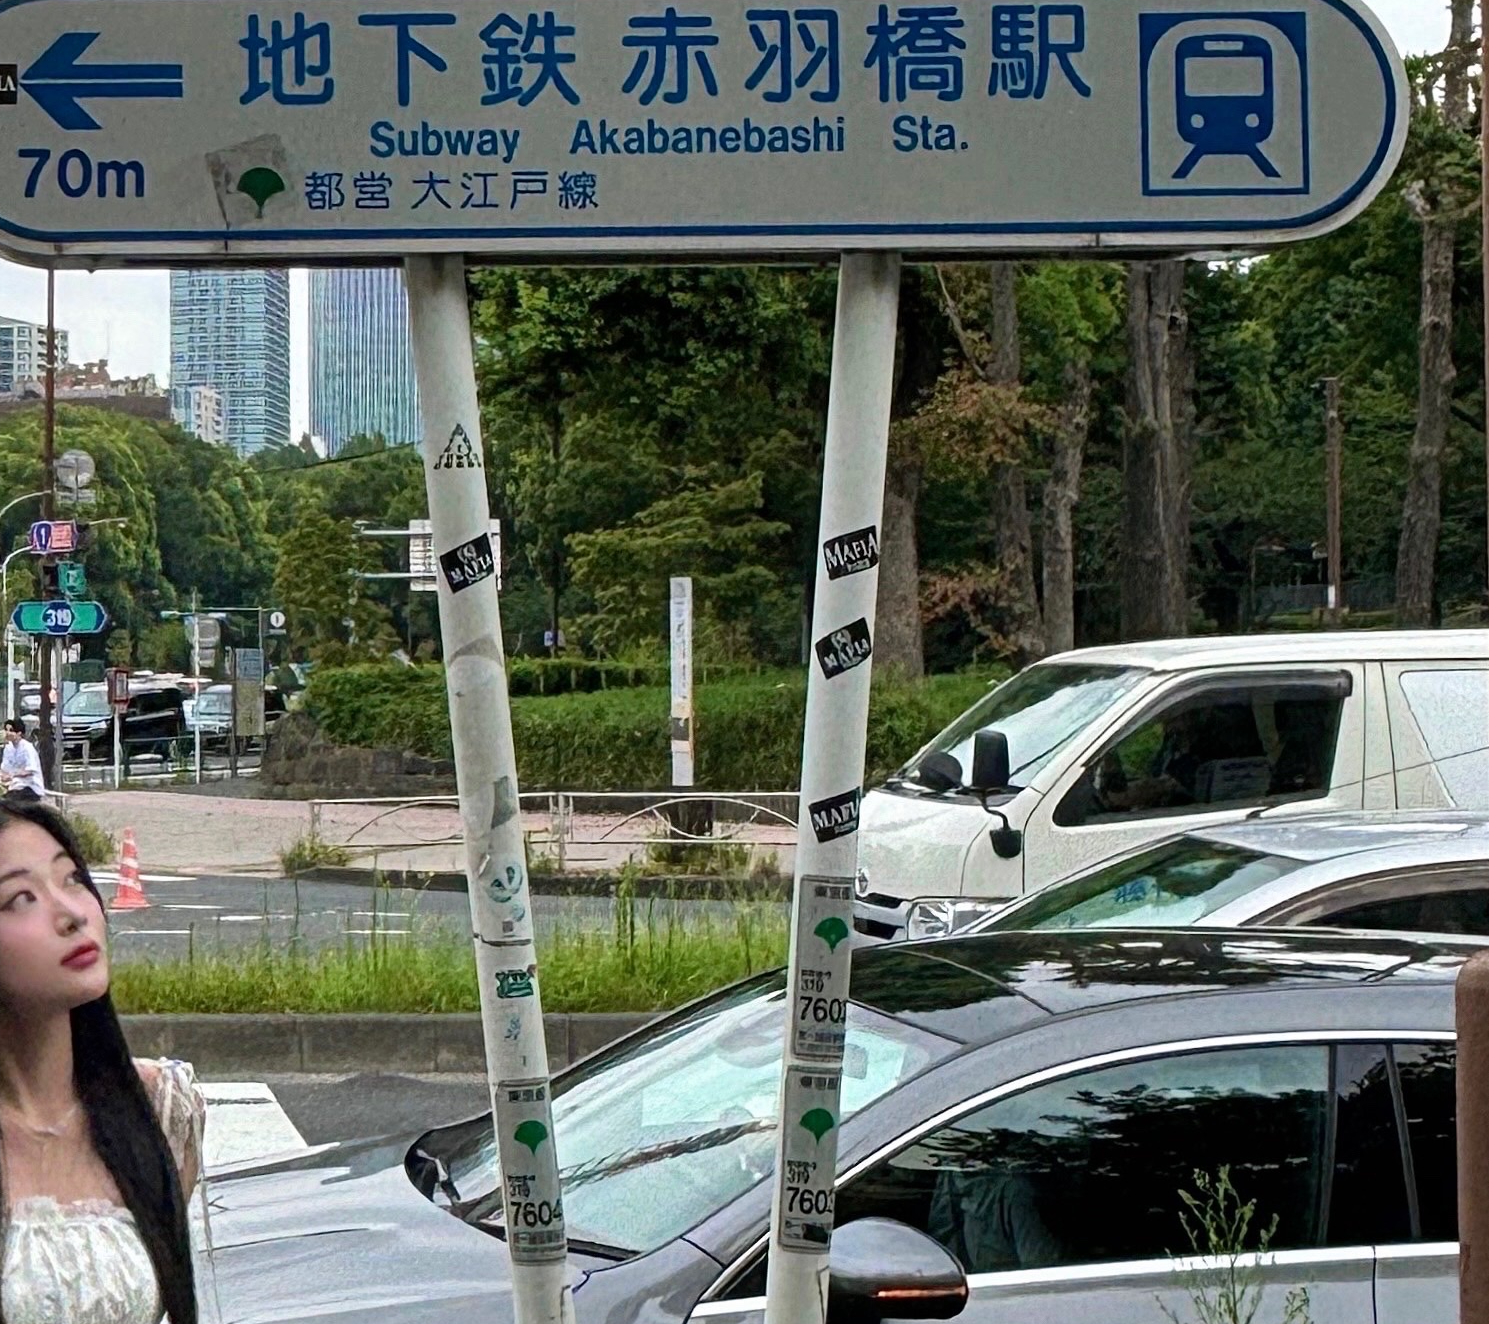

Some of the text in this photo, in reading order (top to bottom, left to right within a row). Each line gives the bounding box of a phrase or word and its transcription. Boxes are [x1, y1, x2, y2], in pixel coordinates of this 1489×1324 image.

[369, 115, 969, 162] Subway Akabanebashi Sta.
[17, 148, 145, 199] 70m
[825, 533, 880, 570] MAFIA
[45, 608, 72, 627] 319
[800, 995, 846, 1025] 760
